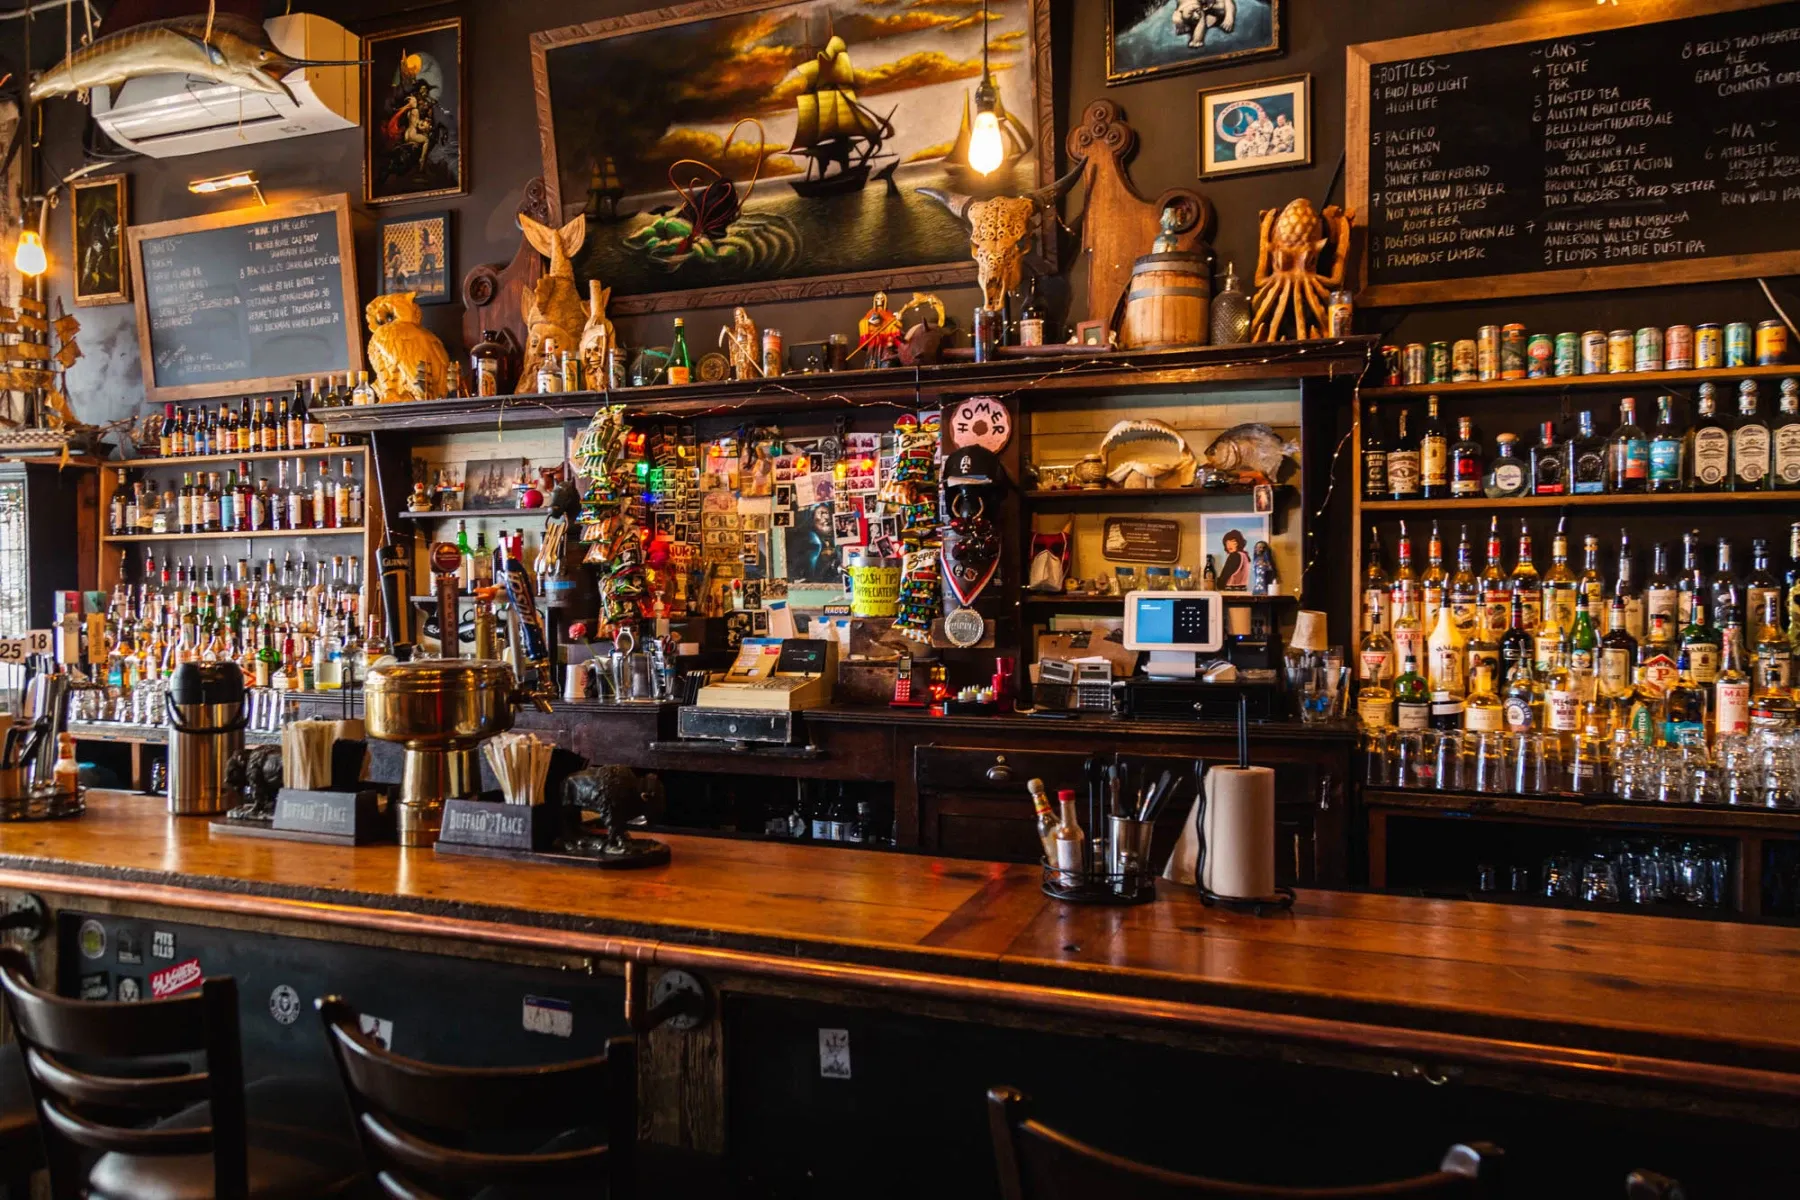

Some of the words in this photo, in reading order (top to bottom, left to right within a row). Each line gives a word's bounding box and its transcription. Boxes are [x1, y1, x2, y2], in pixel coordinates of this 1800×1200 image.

[1545, 42, 1576, 59] CANS
[1681, 42, 1692, 59] 8
[1380, 60, 1435, 84] BOTTLES
[1546, 59, 1589, 77] TECATE
[1733, 61, 1770, 79] BACK
[1412, 82, 1435, 96] BUD
[1437, 76, 1468, 92] LIGHT
[1548, 77, 1570, 92] PBR
[1718, 75, 1771, 97] COUNTRY
[1385, 99, 1413, 115] HIGH
[1417, 96, 1438, 110] LIFE
[1547, 88, 1595, 106] TWISTED
[1598, 87, 1620, 100] TEA
[1547, 105, 1588, 121] AUSTIN
[1620, 97, 1653, 112] CIDER
[1611, 114, 1653, 130] HEARTED
[1654, 111, 1674, 125] ALE
[1731, 122, 1755, 138] NA
[1372, 132, 1380, 145] 5
[1385, 126, 1435, 143] PACIFICO
[1545, 137, 1589, 151] DOGFISH
[1591, 134, 1616, 147] HEAD
[1385, 144, 1410, 158] BLUE
[1413, 141, 1440, 155] MOON
[1625, 143, 1648, 155] ALE
[1720, 140, 1778, 159] ATHLETIC
[1385, 156, 1432, 172] MAGNERS
[1544, 163, 1592, 178] SIXPOINT
[1597, 159, 1630, 174] SWEET
[1633, 156, 1673, 171] ACTION
[1384, 173, 1419, 188] SHINER
[1422, 169, 1447, 182] RUBY
[1449, 165, 1490, 180] REDBIRD
[1544, 177, 1598, 192] BROOKLYN
[1602, 174, 1639, 188] LAGER
[1372, 192, 1380, 208] 7
[1385, 184, 1451, 206] SCRIMSHAW
[1455, 182, 1505, 198] PILSNER
[1543, 194, 1567, 208] TWO
[1629, 185, 1668, 198] SPIKED
[1671, 179, 1716, 194] SELTZER
[1721, 191, 1745, 206] RUN
[1385, 207, 1405, 221] NOT
[1408, 204, 1434, 217] YOUR
[1438, 197, 1487, 214] FATHERS
[1402, 219, 1429, 232] ROOT
[1430, 215, 1461, 228] BEER
[1525, 220, 1536, 234] 7
[1544, 217, 1603, 232] JUNESHINE
[1635, 210, 1690, 227] KOMBUCHA
[1385, 233, 1425, 250] DOGFISH
[1428, 231, 1457, 245] HEAD
[1460, 225, 1495, 241] PUNKIN
[1498, 224, 1515, 237] ALE
[1544, 232, 1600, 247] ANDERSON
[1603, 229, 1640, 244] VALLEY
[1644, 226, 1673, 240] GOSE
[1386, 250, 1444, 268] FRAMBOISE
[1556, 247, 1598, 263] FLOYDS
[1603, 242, 1649, 259] ZOMBIE
[1653, 240, 1683, 255] DUST
[1685, 239, 1706, 253] IPA
[957, 403, 1005, 436] HOMER
[0, 643, 22, 659] 25
[30, 634, 47, 649] 18
[282, 801, 315, 821] BUFFALO
[322, 803, 346, 823] TRACE
[450, 809, 486, 830] BUFFALO
[496, 813, 523, 835] TRACE
